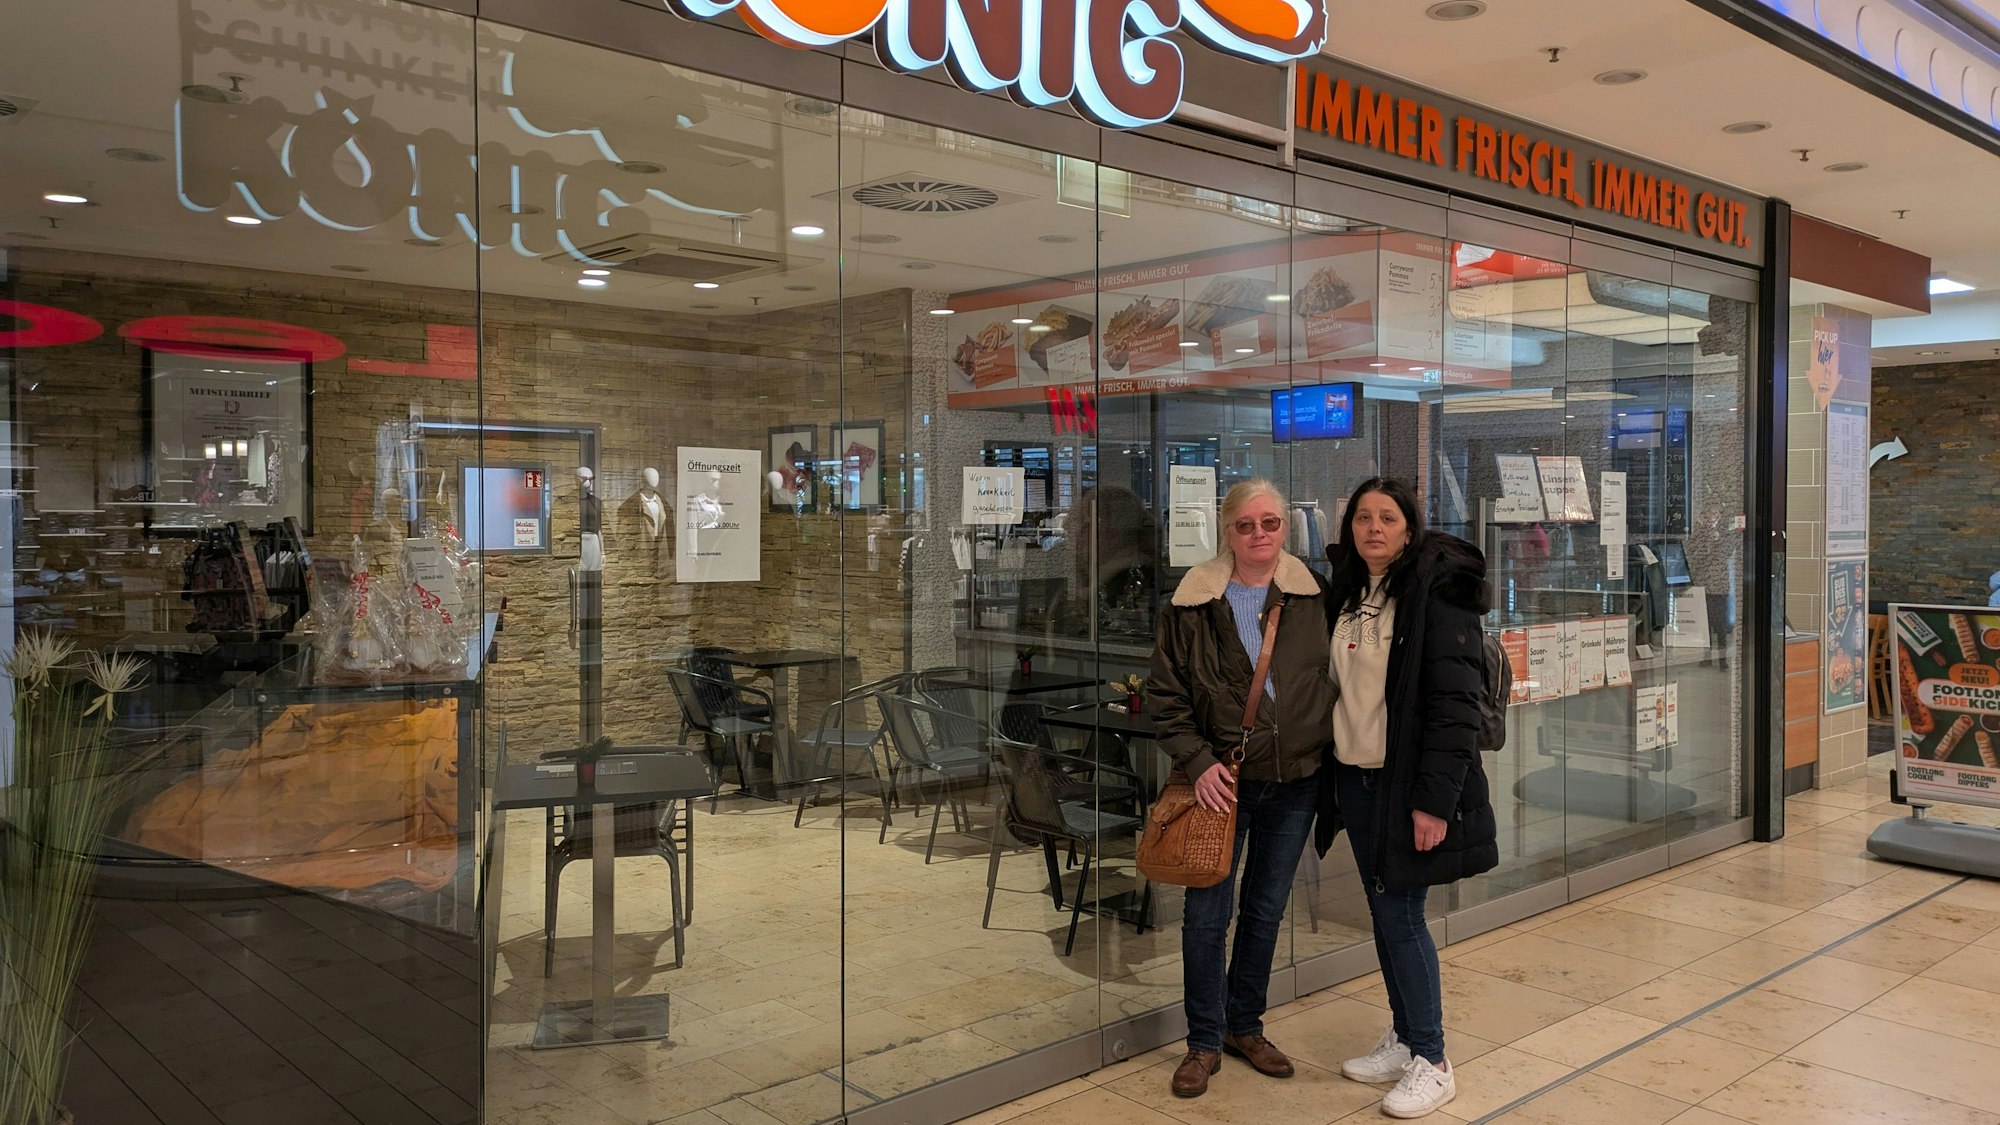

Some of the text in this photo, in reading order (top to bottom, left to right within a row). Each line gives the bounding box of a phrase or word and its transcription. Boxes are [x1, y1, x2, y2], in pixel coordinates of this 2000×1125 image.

[1296, 65, 1752, 248] IMMER FRISCH, IMMER GUT.
[1104, 272, 1136, 287] FRISCH,
[1137, 266, 1167, 281] IMMER
[1169, 263, 1191, 276] GUT.
[1814, 330, 1838, 344] PICK UP
[1104, 381, 1136, 393] FRISCH,
[1137, 378, 1167, 390] IMMER
[1169, 376, 1191, 387] GUT.
[189, 387, 273, 399] MEISTERBRIEF
[687, 460, 742, 473] Öffnungszeit
[1175, 476, 1207, 485] Öffnungszeit
[1541, 474, 1580, 484] Linsen-
[1544, 487, 1576, 496] suppe
[1581, 639, 1601, 648] Grünkohl
[1606, 636, 1627, 645] Möhren-
[1530, 647, 1547, 656] Sauer-
[1606, 646, 1625, 657] gemüse
[1530, 657, 1545, 665] kraut
[1961, 676, 1989, 684] NEU!
[1907, 765, 1997, 784] FOOTLONG FOOTLONG
[1907, 772, 1990, 789] COOKIE DIPPERS
